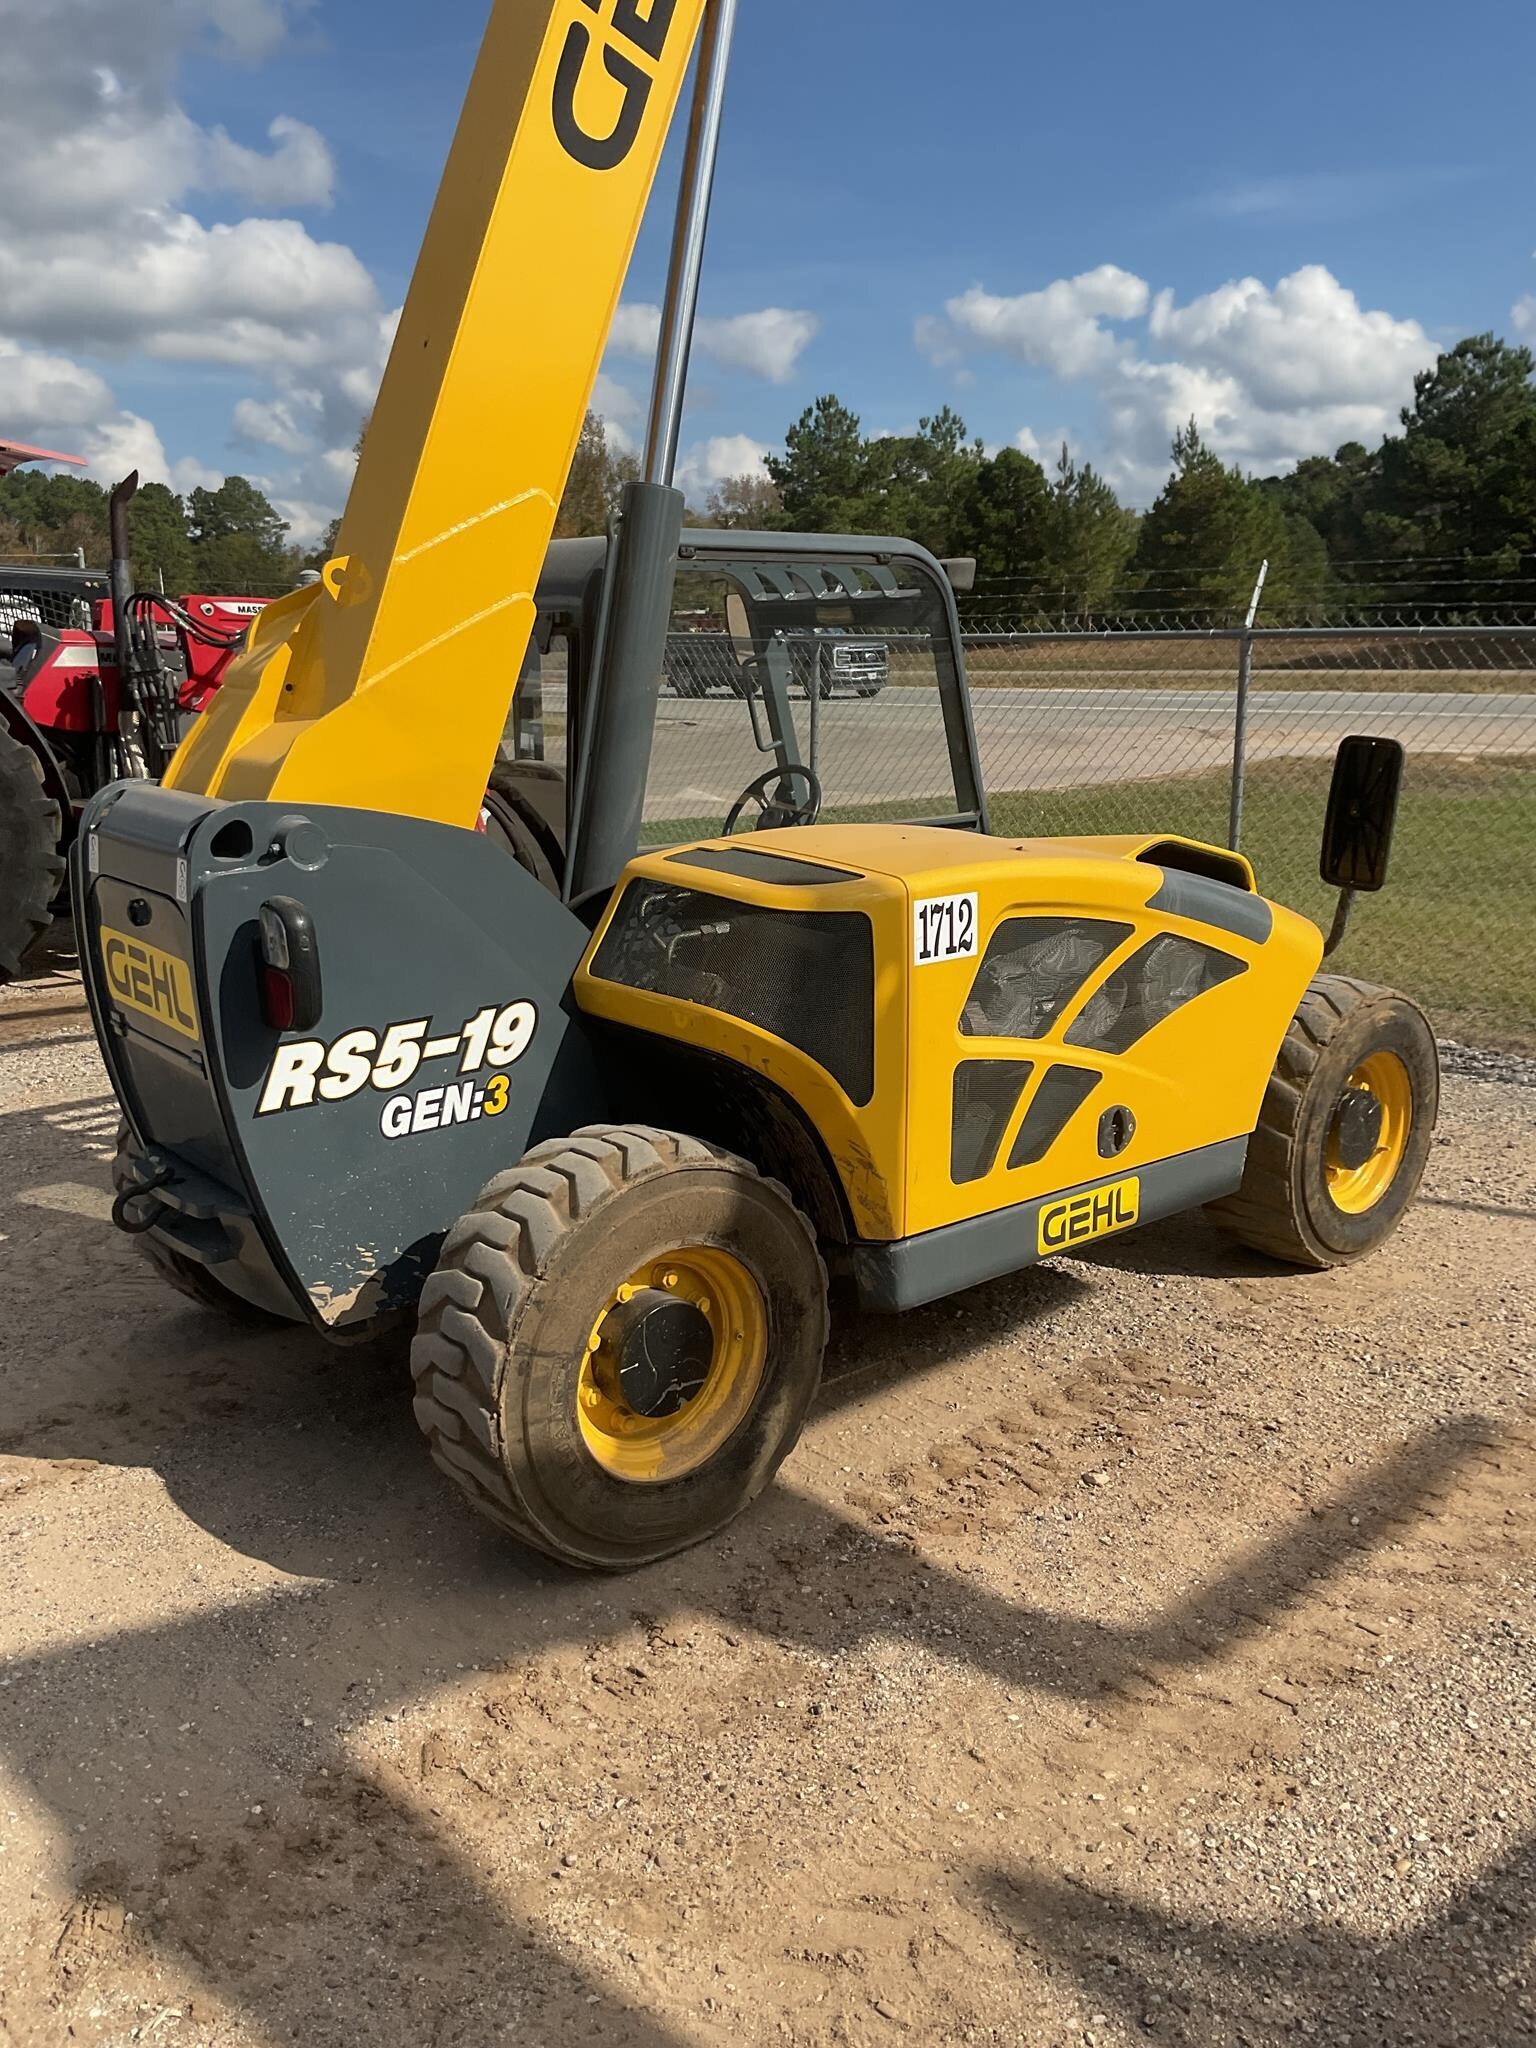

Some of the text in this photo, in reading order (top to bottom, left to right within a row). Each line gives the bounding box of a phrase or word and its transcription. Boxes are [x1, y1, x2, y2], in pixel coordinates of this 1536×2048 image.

[919, 898, 973, 959] 1712
[106, 938, 195, 1030] GEHL
[255, 999, 538, 1116] RS5-19
[1043, 1186, 1135, 1246] GEHL
